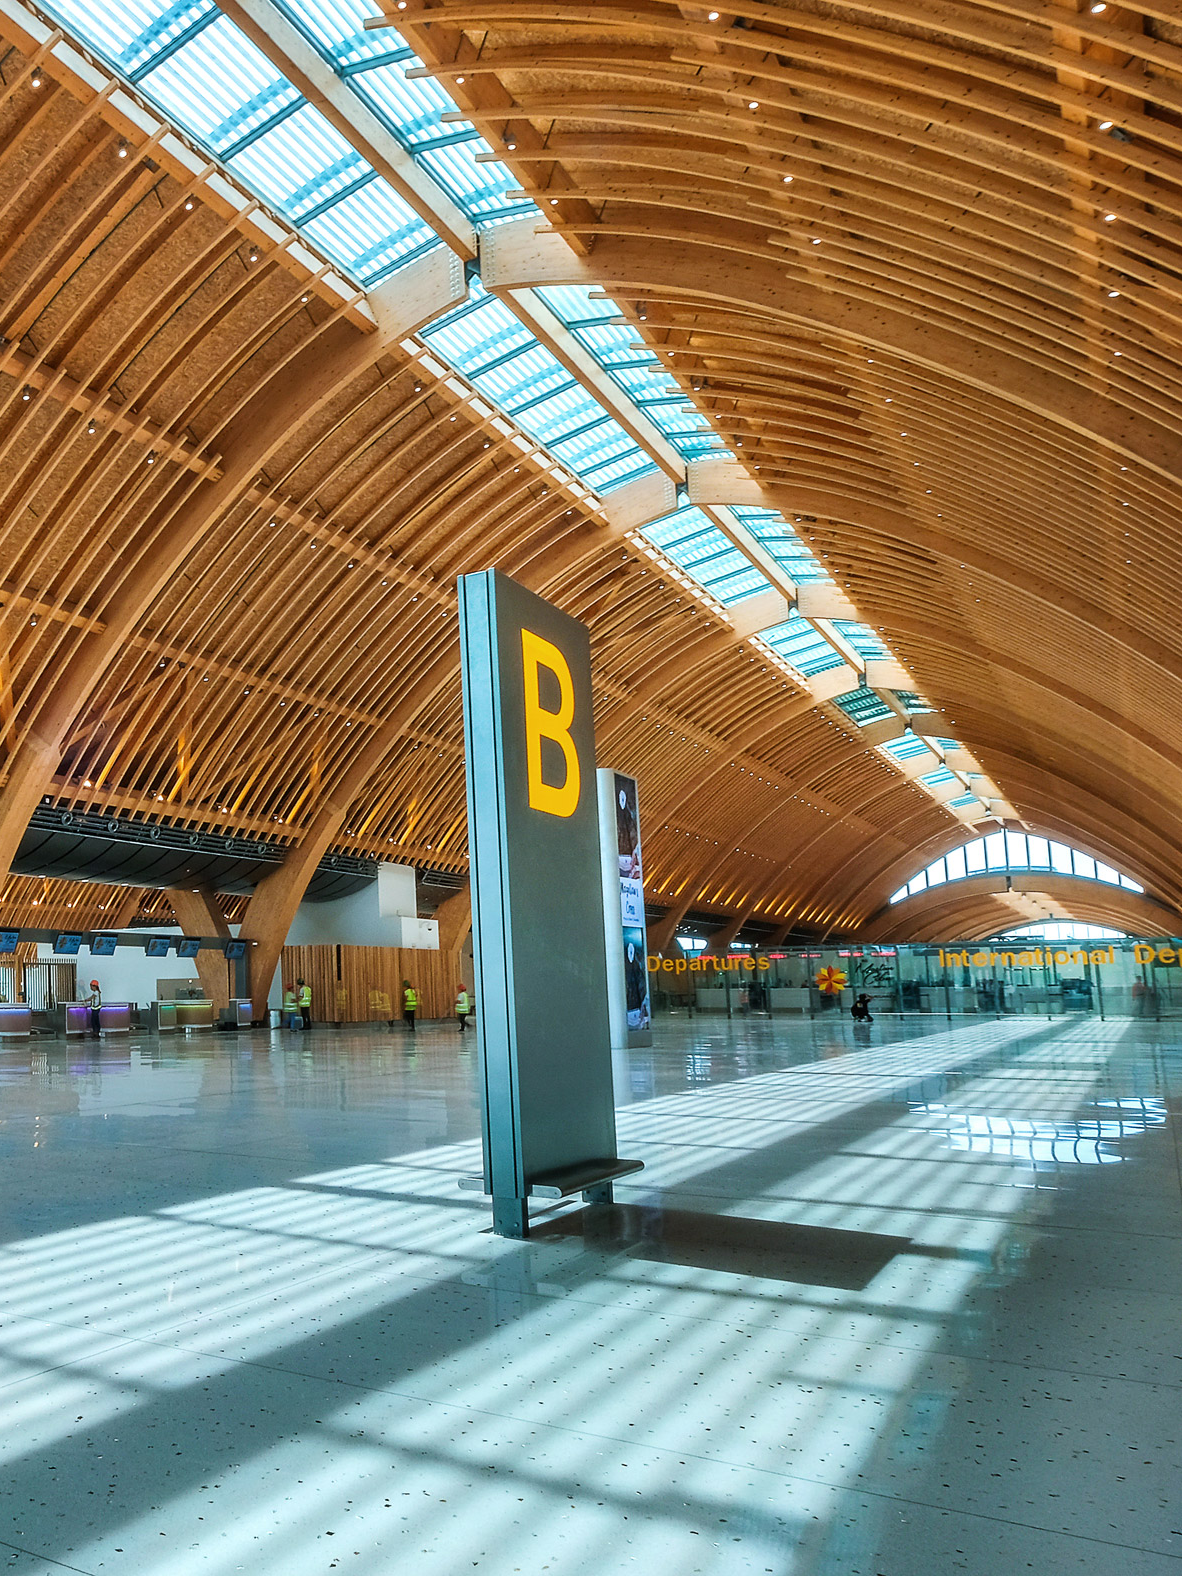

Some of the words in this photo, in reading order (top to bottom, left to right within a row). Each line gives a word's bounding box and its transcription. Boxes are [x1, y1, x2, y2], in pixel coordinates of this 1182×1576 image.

[520, 627, 581, 818] B
[646, 955, 771, 975] Departures
[939, 945, 1115, 968] International
[1134, 944, 1182, 968] De
